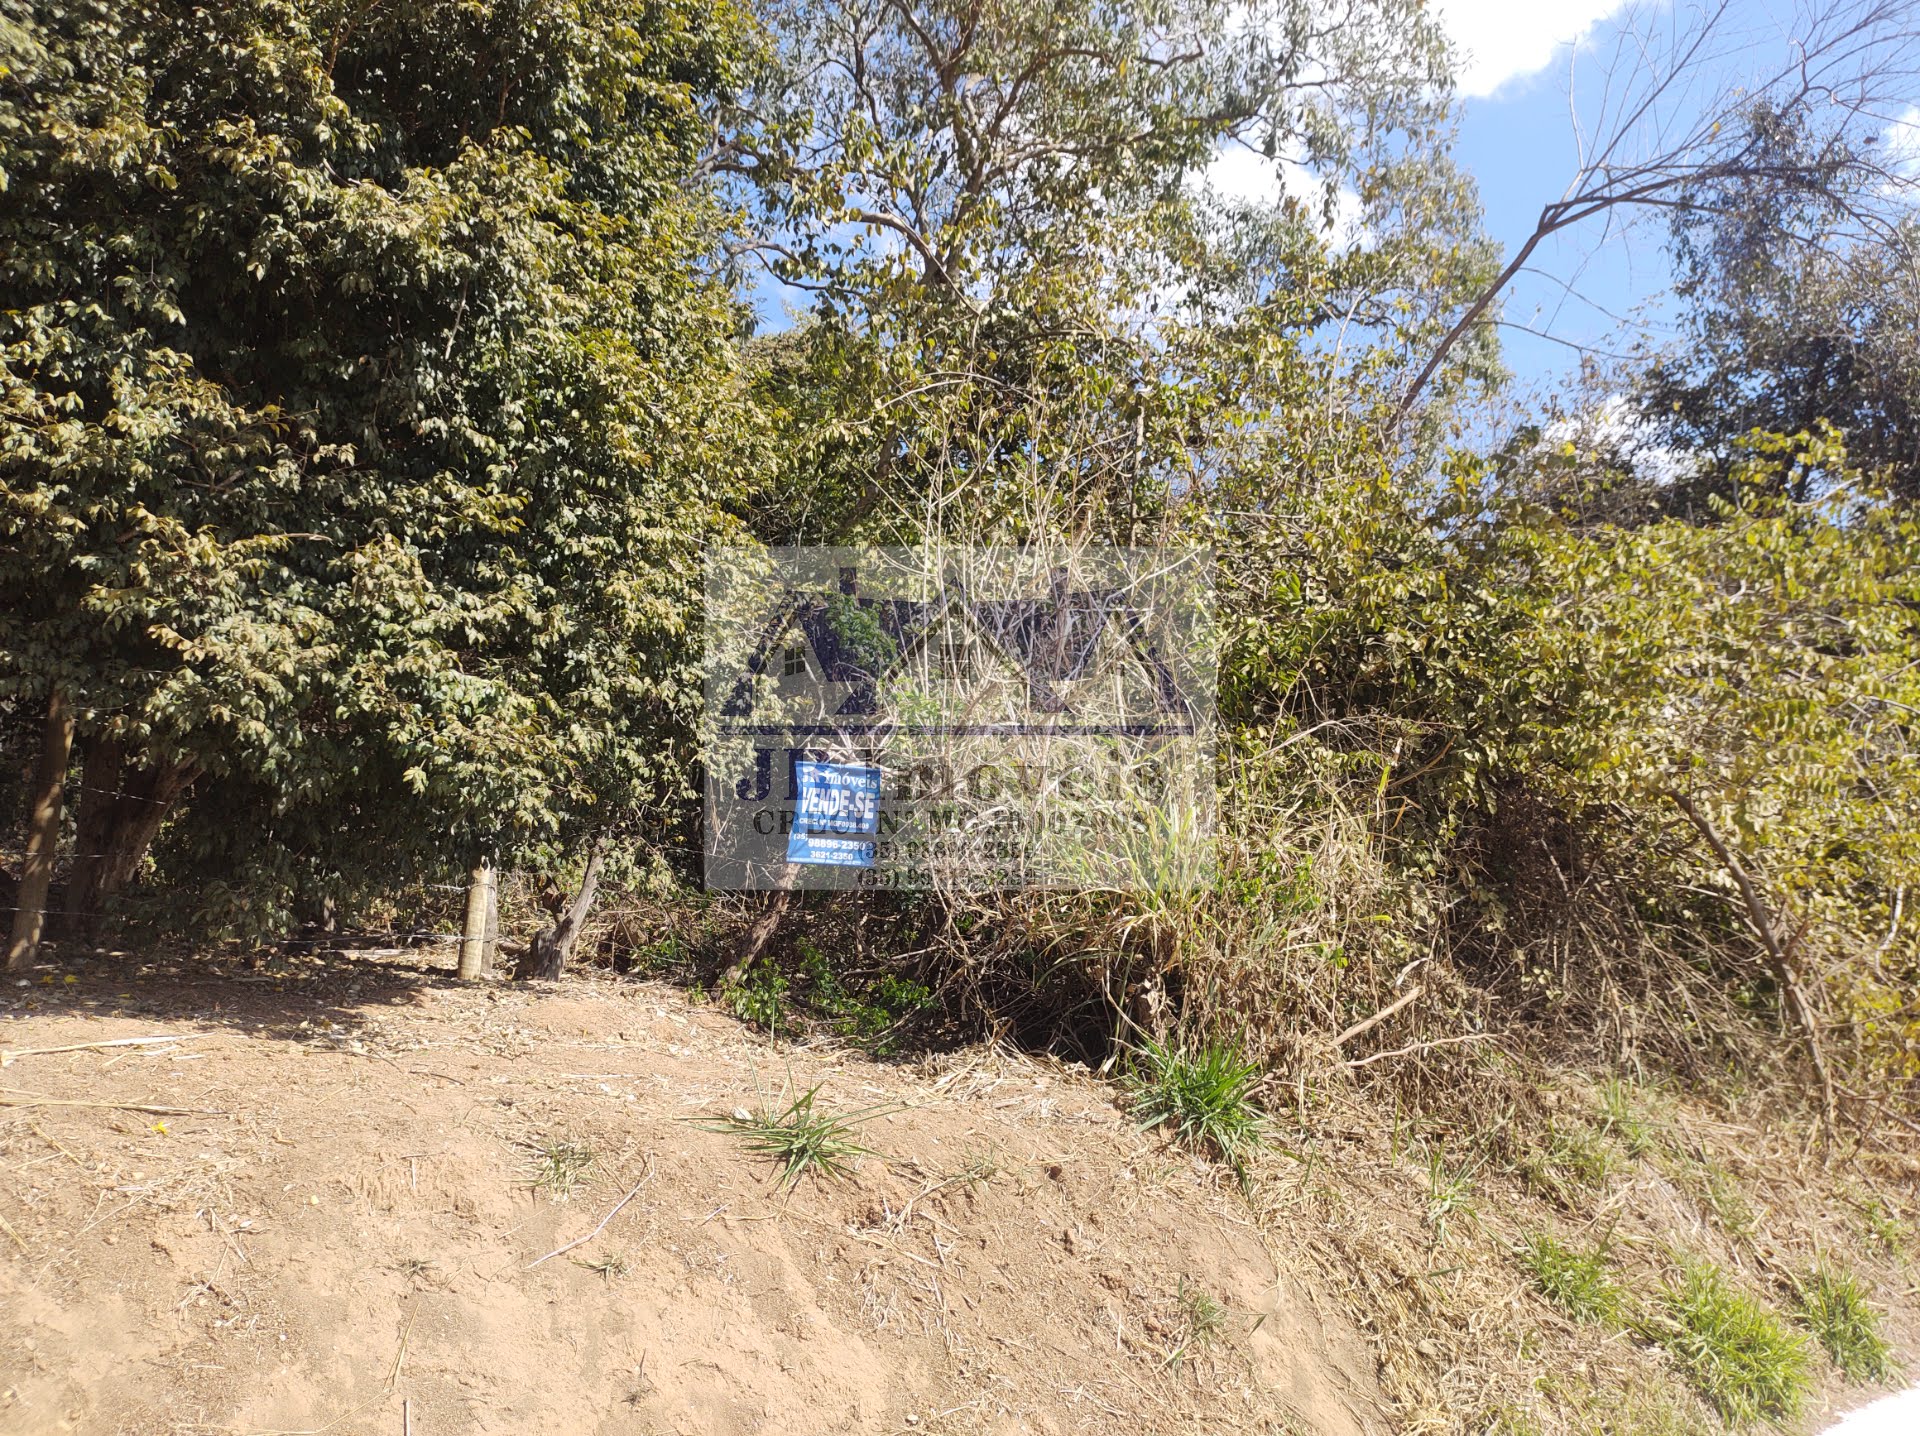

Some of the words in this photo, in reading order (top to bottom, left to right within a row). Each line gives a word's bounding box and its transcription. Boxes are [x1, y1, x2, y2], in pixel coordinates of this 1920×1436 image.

[801, 786, 876, 819] VENDE-SE
[808, 838, 866, 851] 98896-2350
[810, 850, 854, 861] 3621-2350
